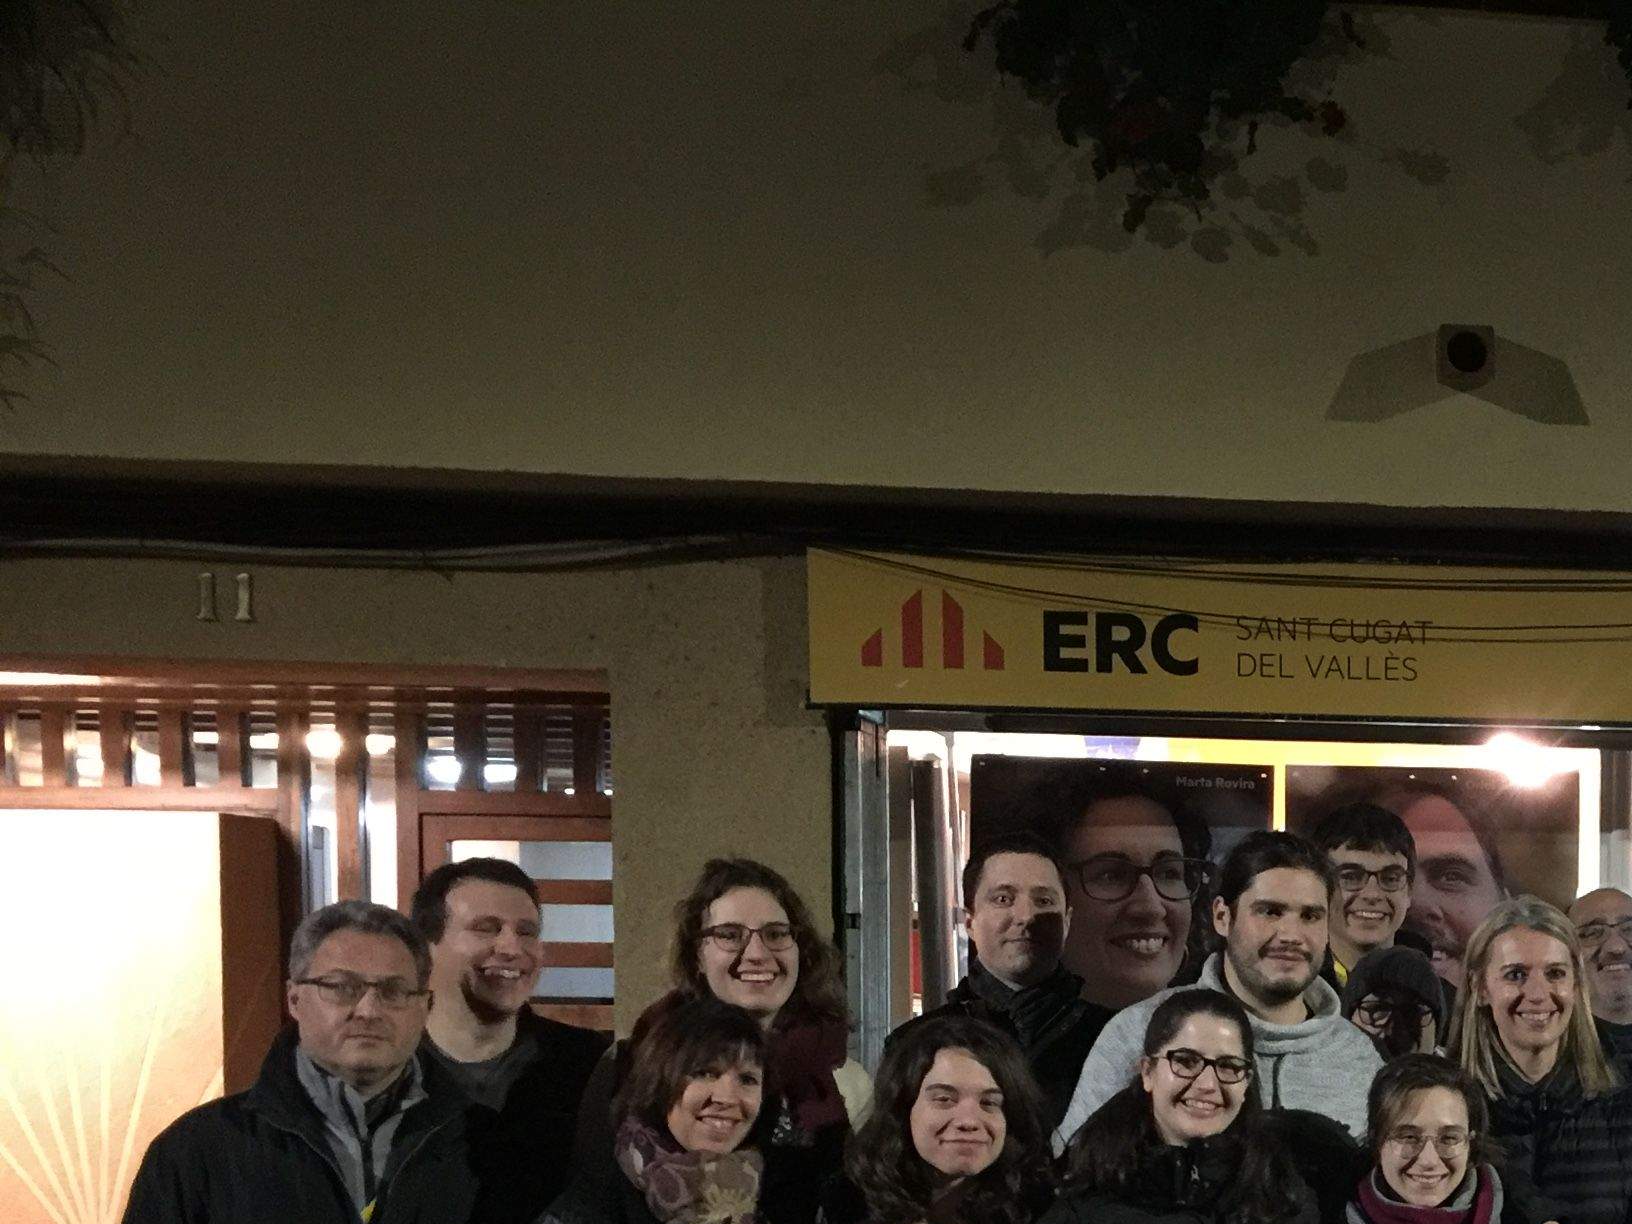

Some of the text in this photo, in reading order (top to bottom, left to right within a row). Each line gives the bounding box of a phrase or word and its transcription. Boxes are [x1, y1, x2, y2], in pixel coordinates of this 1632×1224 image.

[195, 572, 253, 621] 11
[1043, 611, 1199, 676] ERC
[1235, 615, 1434, 645] SANT CUGAT
[1236, 650, 1419, 682] DEL VALLÈS
[1175, 775, 1256, 790] Marta Rovira
